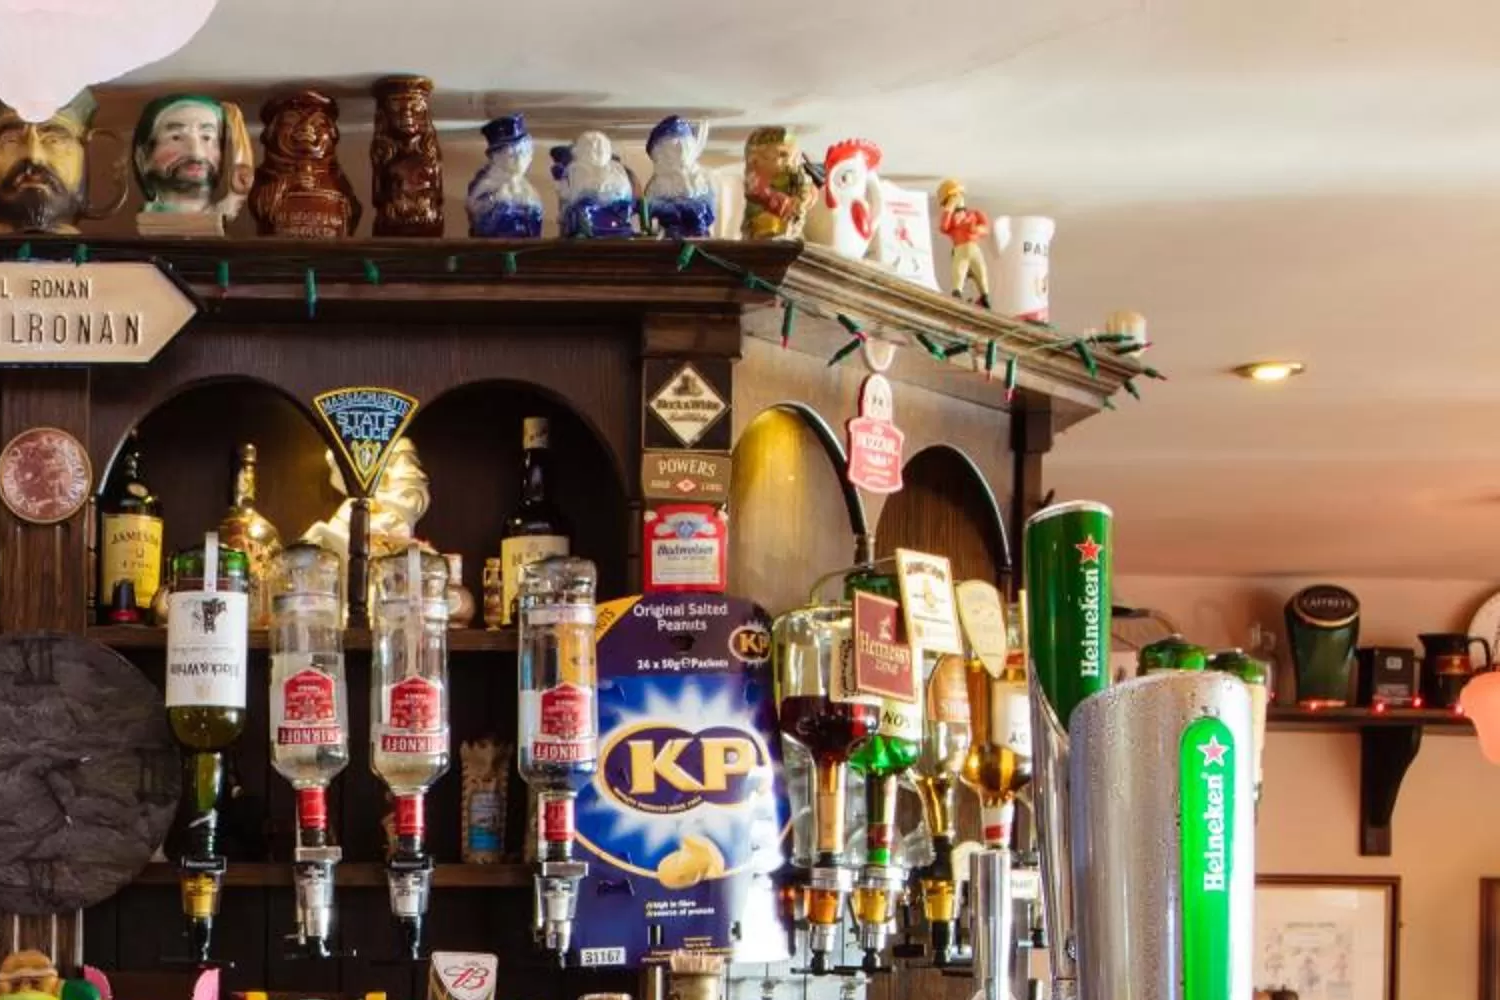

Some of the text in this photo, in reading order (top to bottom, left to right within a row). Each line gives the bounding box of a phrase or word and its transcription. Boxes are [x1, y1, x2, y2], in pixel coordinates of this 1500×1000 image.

[30, 279, 90, 299] RONAN
[336, 412, 396, 427] STATE
[342, 426, 389, 440] POLICE
[658, 459, 717, 477] POWERS
[633, 603, 729, 618] Original Salted
[657, 619, 707, 631] Peanuts
[1080, 568, 1100, 677] Heineken
[739, 634, 768, 653] KP
[628, 736, 758, 794] KP
[1203, 774, 1225, 892] Heineken
[585, 951, 620, 963] 31167
